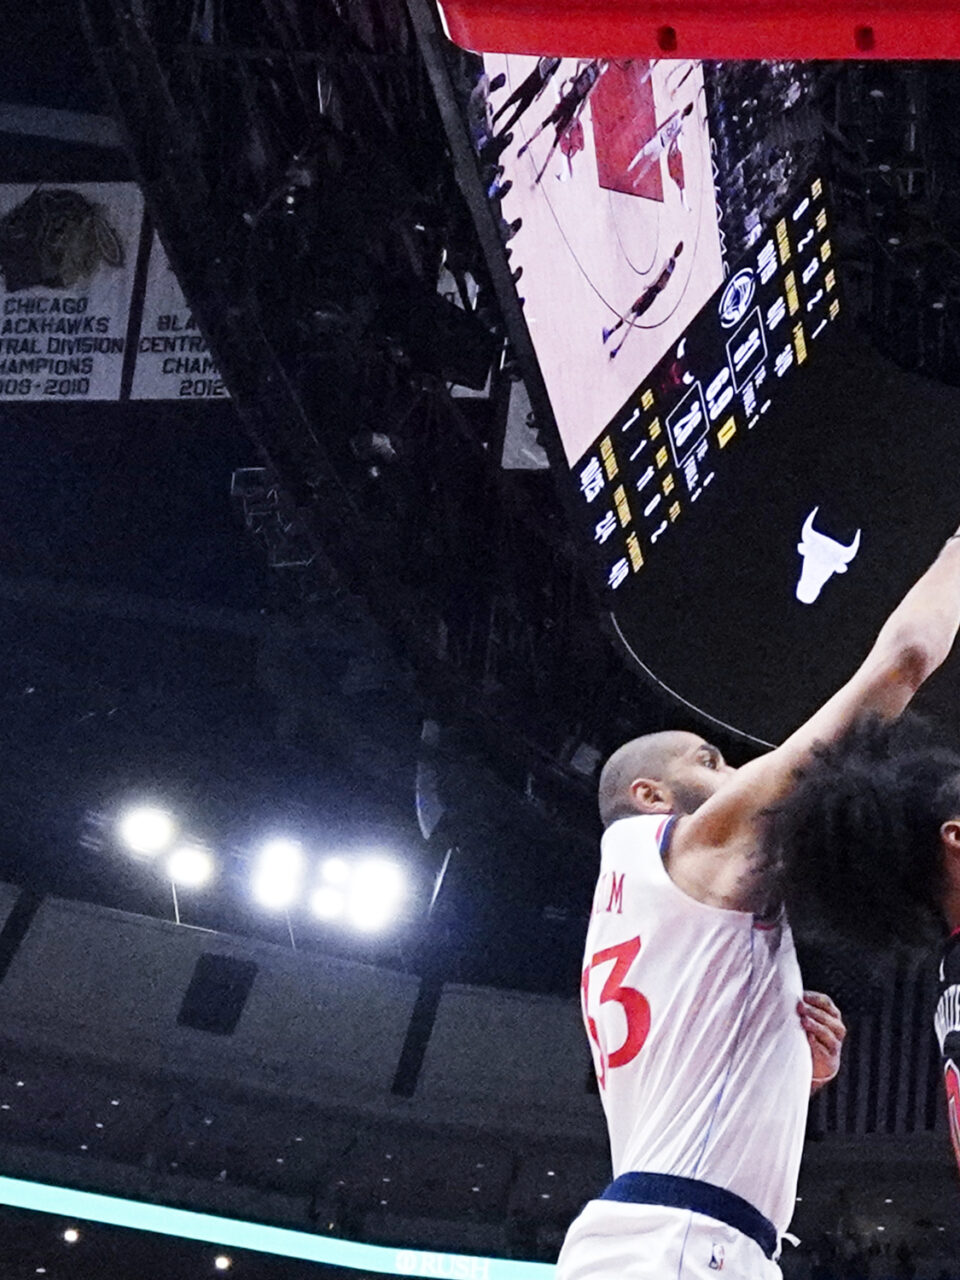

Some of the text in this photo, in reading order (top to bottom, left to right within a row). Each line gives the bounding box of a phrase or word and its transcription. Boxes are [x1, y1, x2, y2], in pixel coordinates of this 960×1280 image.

[4, 297, 88, 315] CHICAGO
[47, 337, 124, 354] DIVISION
[421, 1254, 490, 1280] RUSH
